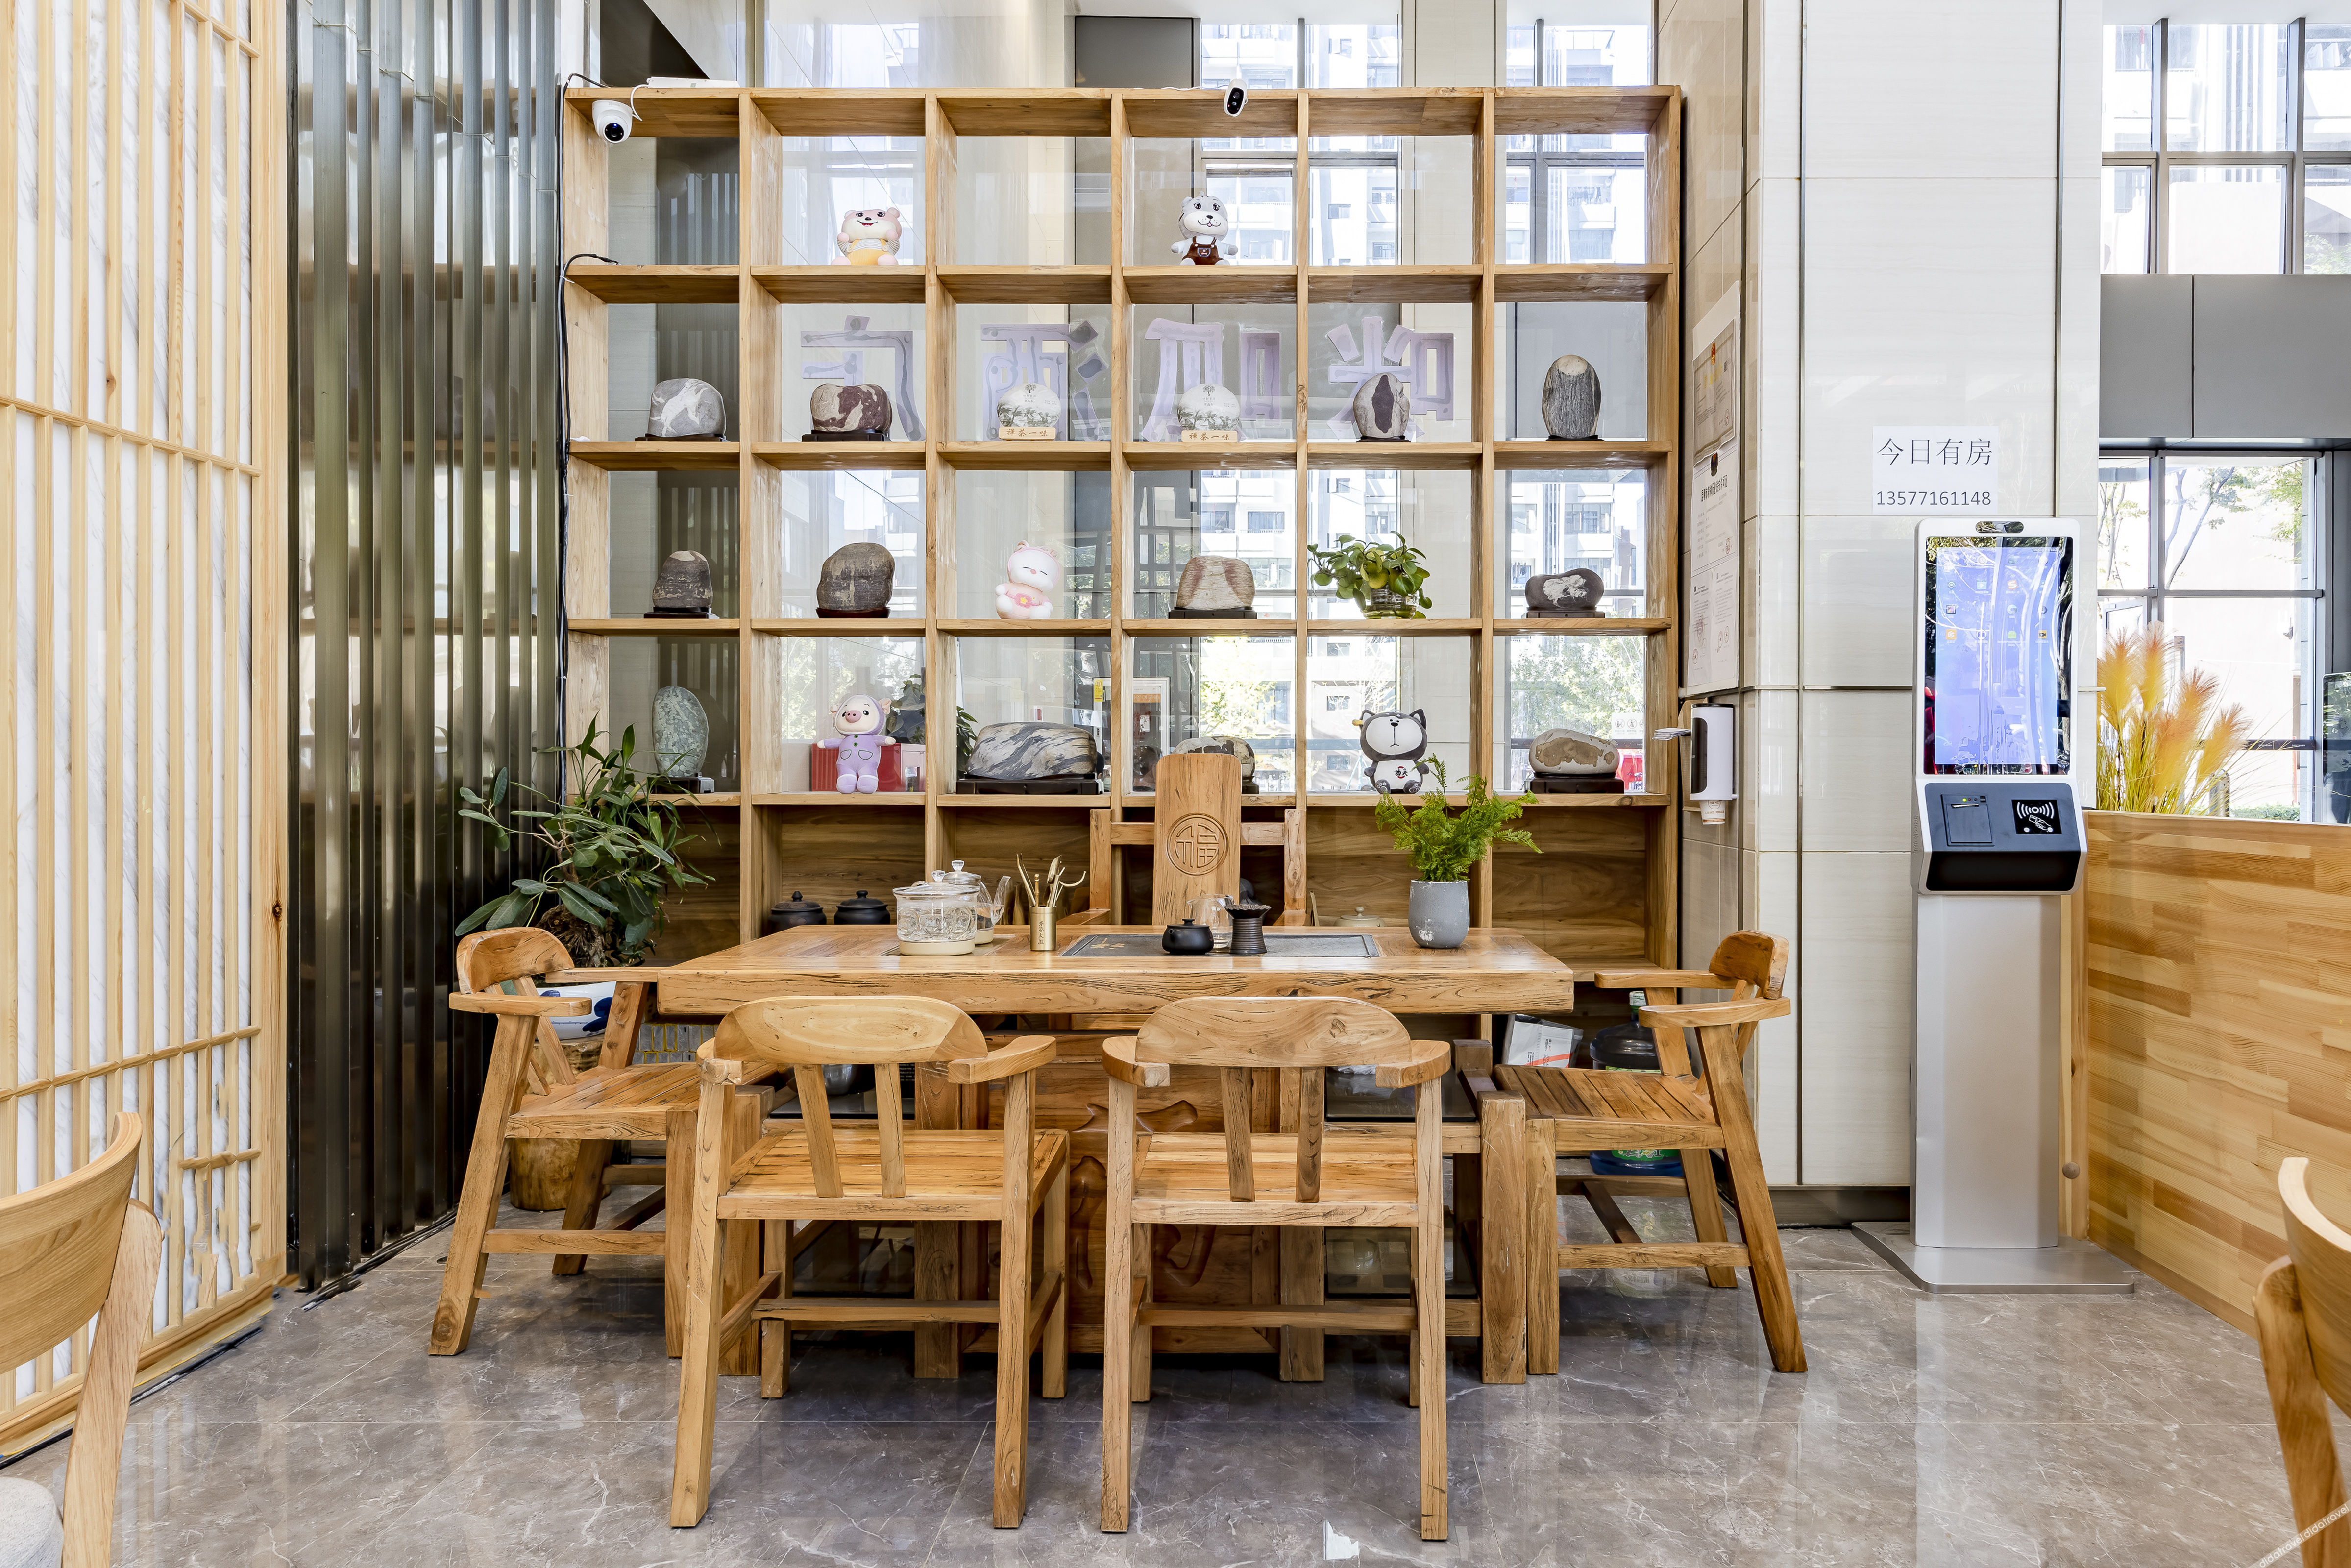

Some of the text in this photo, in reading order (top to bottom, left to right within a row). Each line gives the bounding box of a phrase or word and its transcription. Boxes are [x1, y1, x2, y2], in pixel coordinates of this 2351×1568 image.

[1877, 438, 1992, 466] 今日有房
[1877, 491, 1991, 505] 13577161148
[1174, 823, 1219, 868] 福
